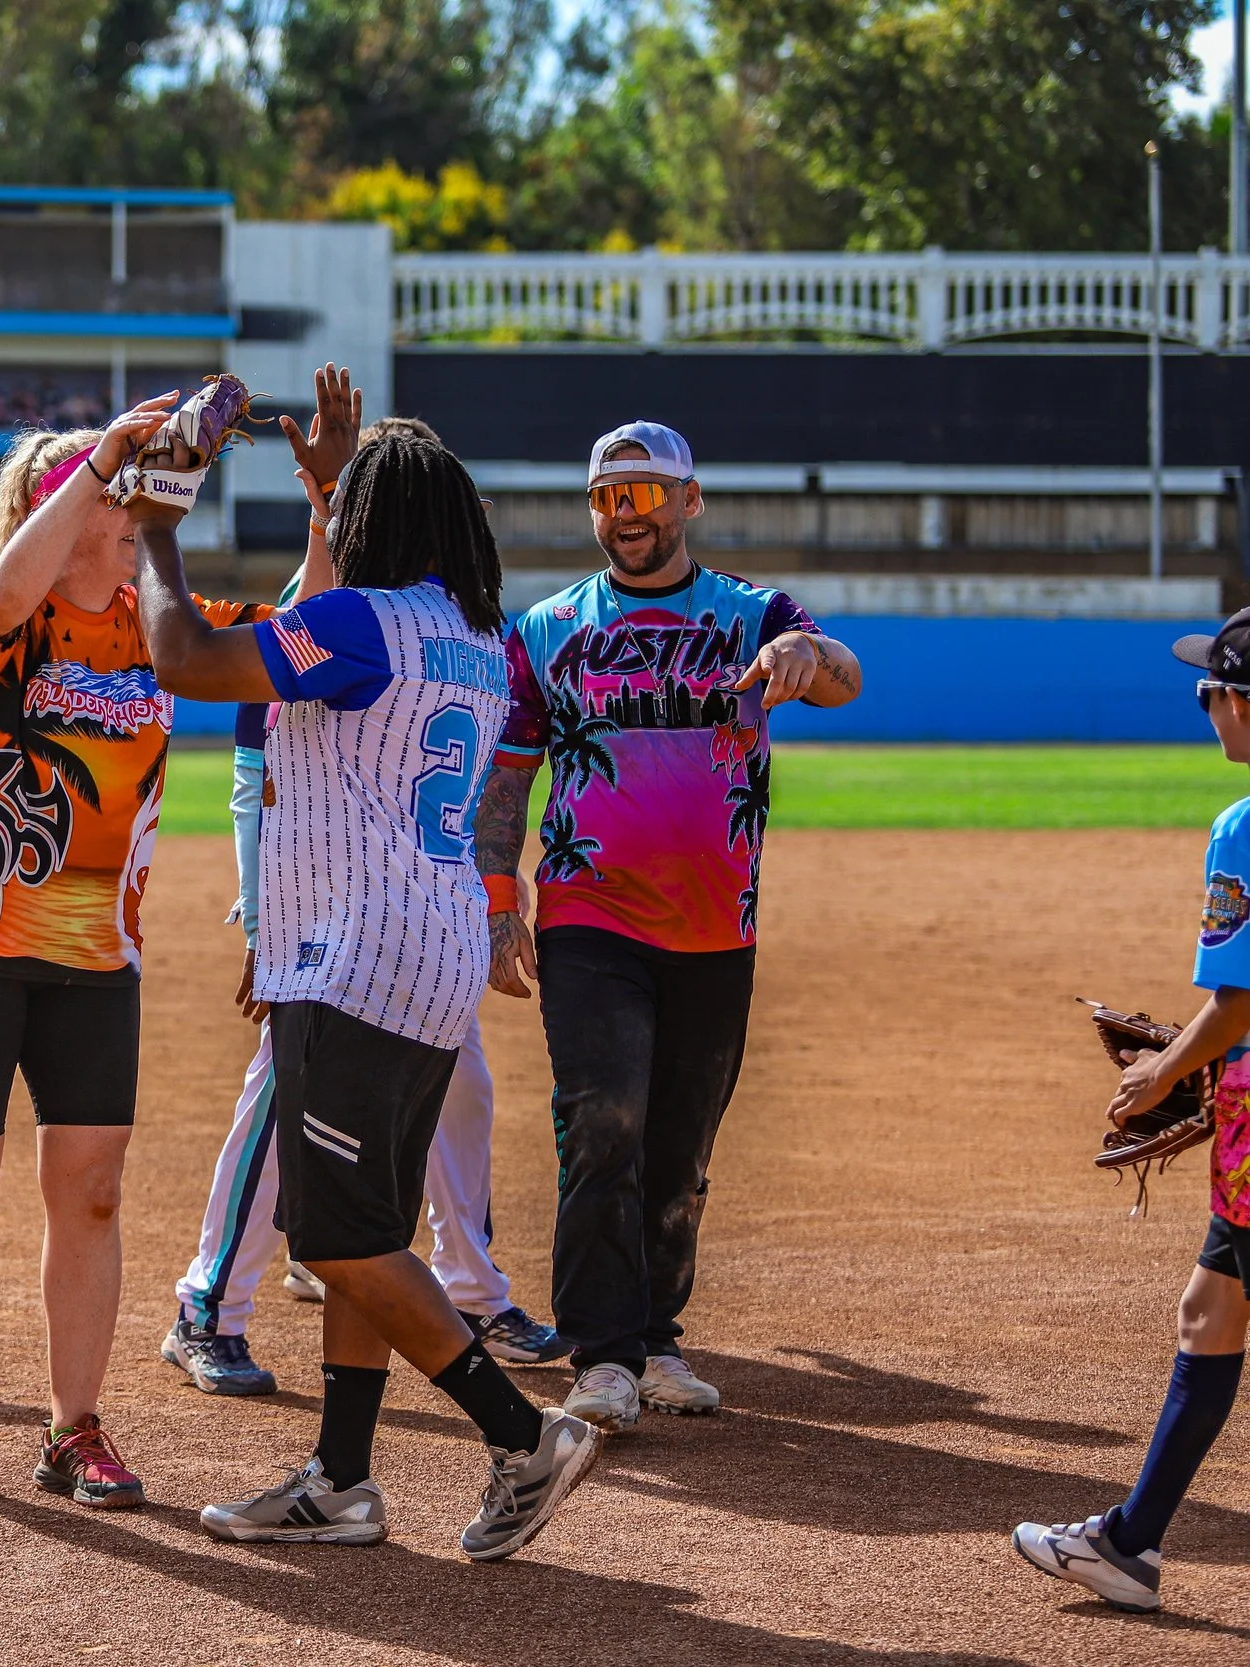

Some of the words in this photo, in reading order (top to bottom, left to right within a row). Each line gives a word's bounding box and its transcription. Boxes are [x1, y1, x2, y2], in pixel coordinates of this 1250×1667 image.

[152, 479, 193, 496] Wilson
[24, 677, 153, 735] THUNDERCATS
[410, 702, 486, 864] 2
